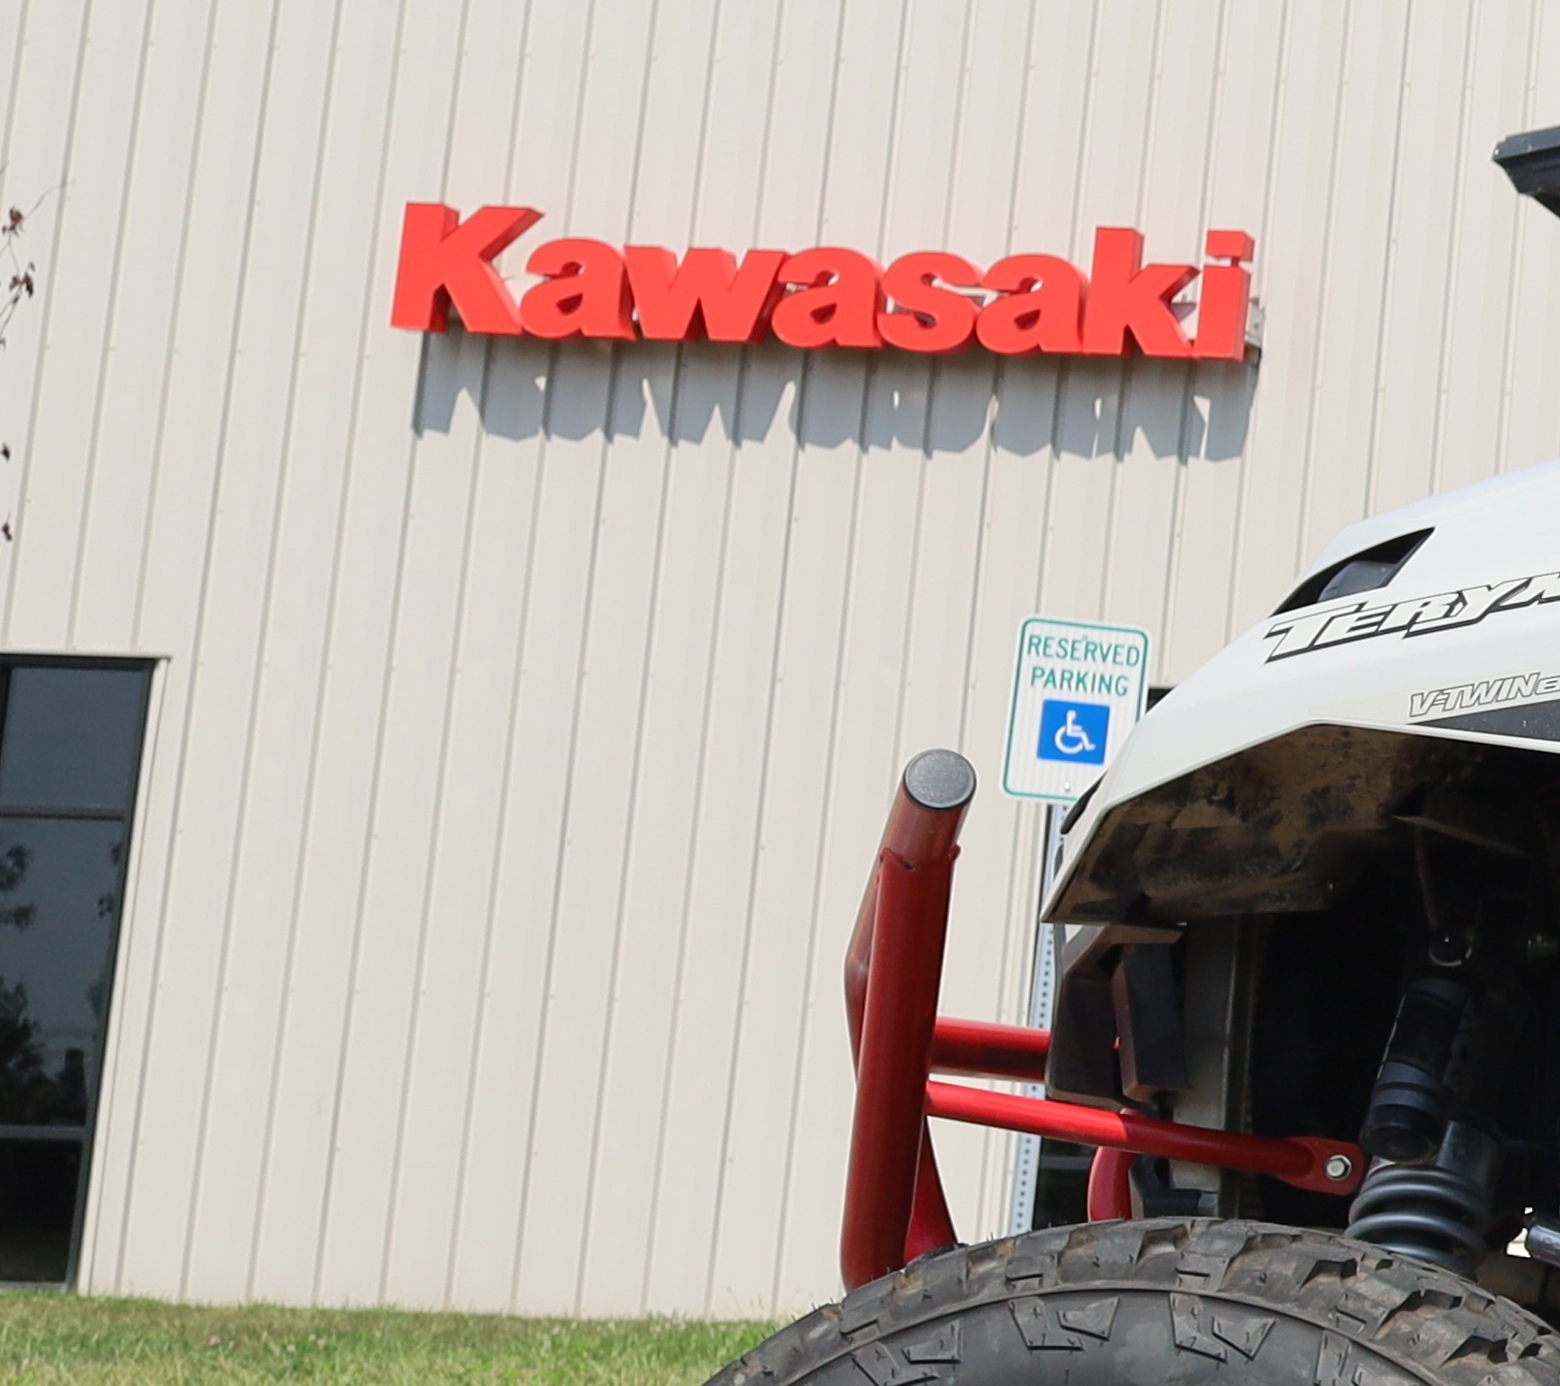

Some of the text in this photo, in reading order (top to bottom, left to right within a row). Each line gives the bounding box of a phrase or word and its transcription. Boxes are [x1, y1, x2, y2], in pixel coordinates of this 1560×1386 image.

[391, 201, 1252, 362] Kawasaki
[1027, 634, 1141, 667] RESERVED
[1030, 666, 1129, 697] PARKING
